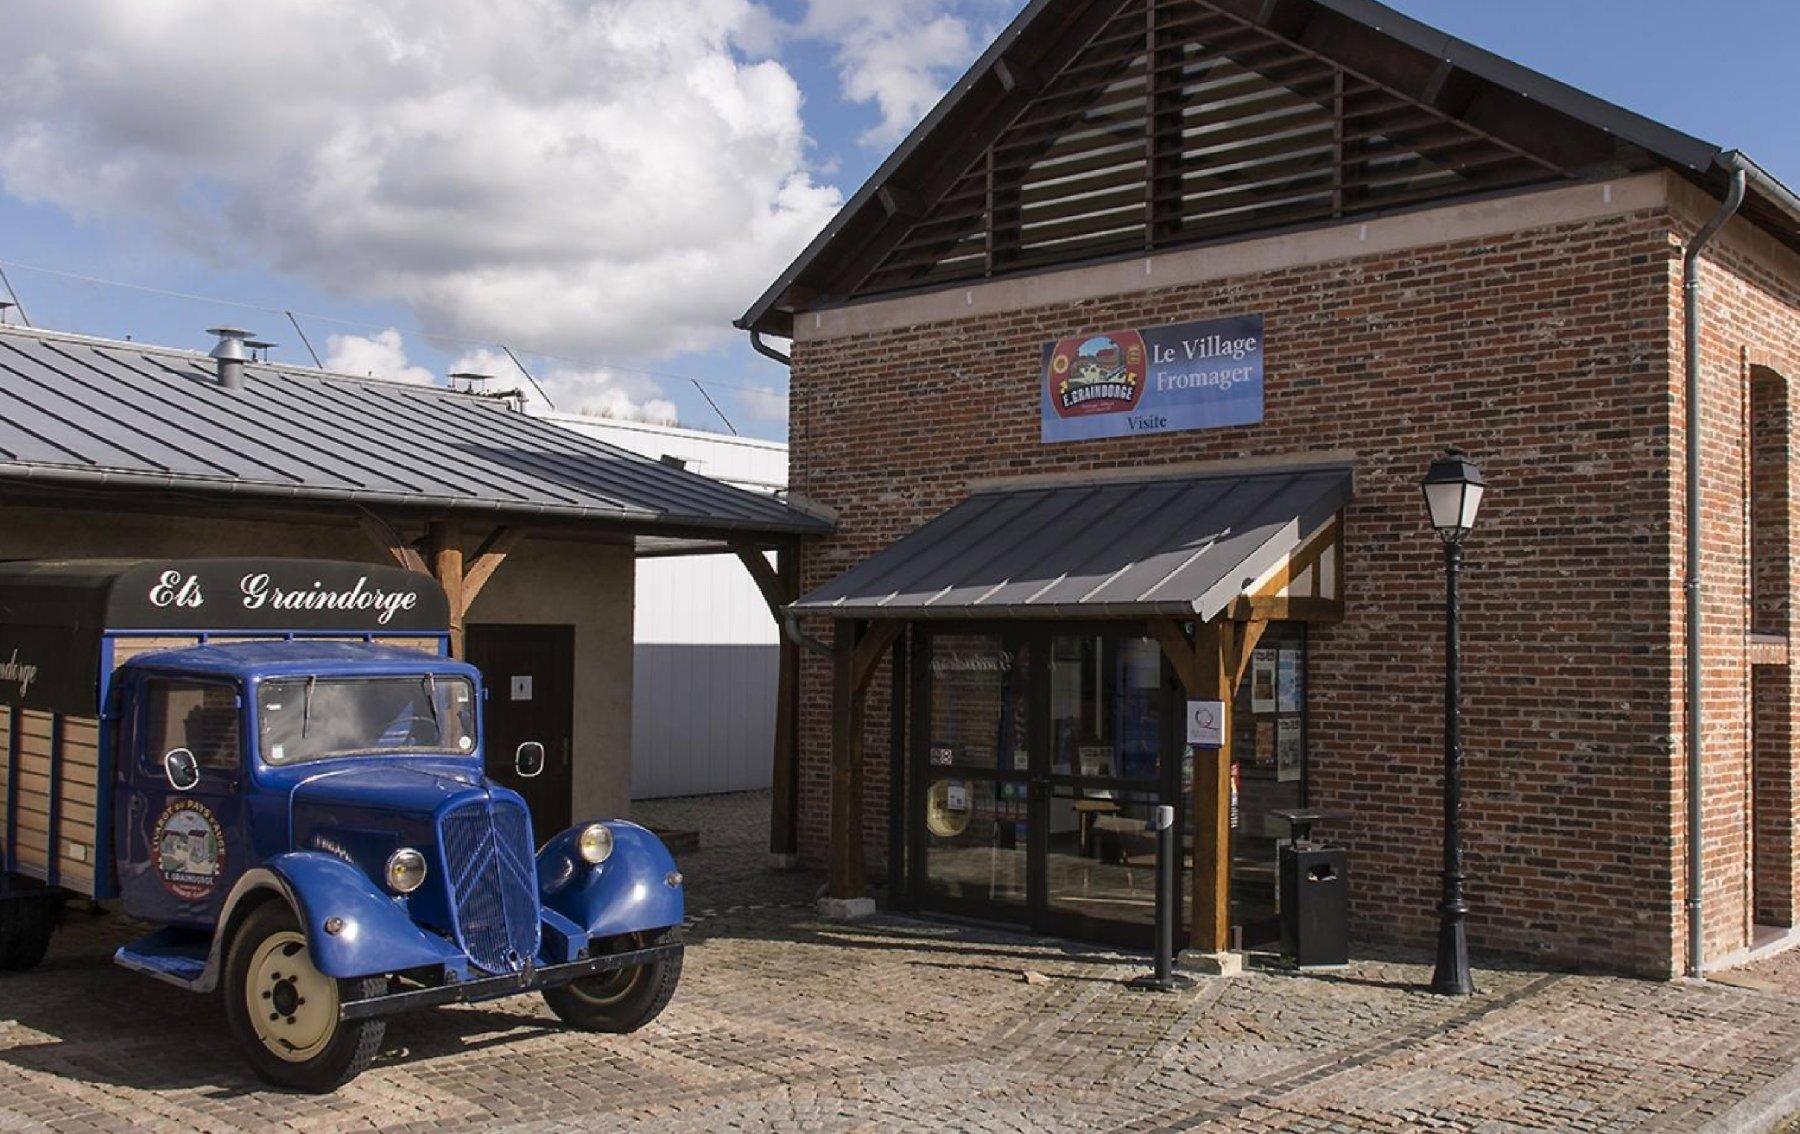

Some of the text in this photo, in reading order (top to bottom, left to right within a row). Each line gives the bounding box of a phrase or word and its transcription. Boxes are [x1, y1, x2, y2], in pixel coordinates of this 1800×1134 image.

[1154, 335, 1257, 364] Le Village
[1157, 366, 1253, 391] Fromager
[1128, 416, 1167, 430] Visite
[149, 570, 416, 624] Ets Graindorge
